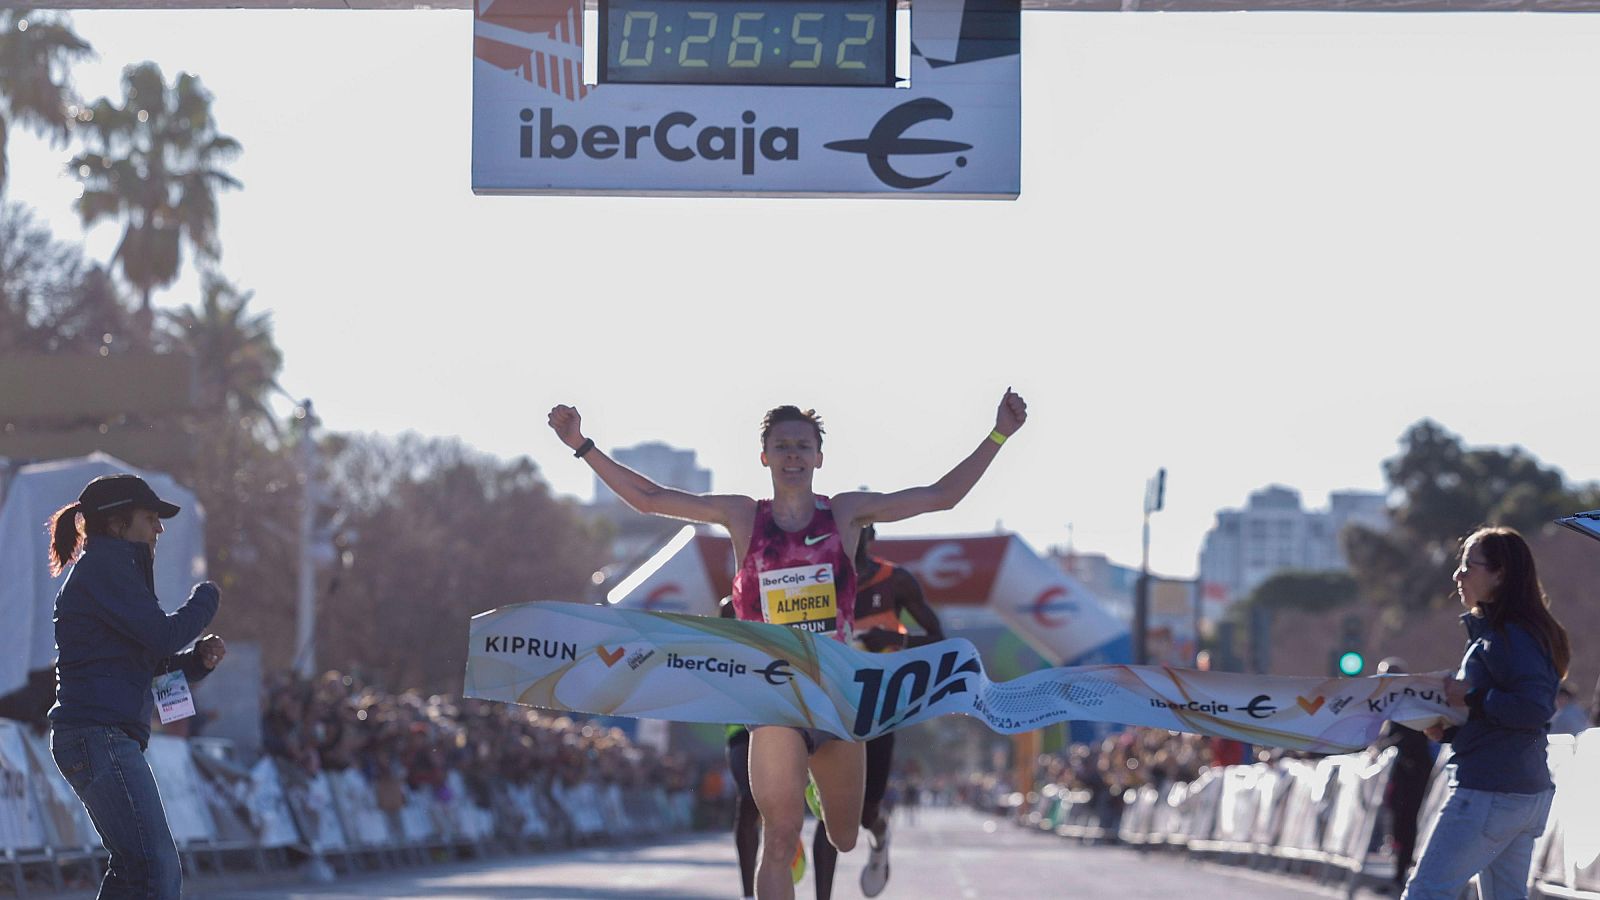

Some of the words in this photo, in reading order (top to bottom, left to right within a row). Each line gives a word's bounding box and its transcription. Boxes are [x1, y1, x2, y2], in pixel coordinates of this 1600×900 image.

[619, 11, 875, 69] 0:26:52
[519, 107, 799, 175] iberCaja
[762, 573, 805, 586] iberCaja
[777, 595, 830, 613] ALMGREN
[792, 621, 826, 633] RUN
[485, 636, 577, 661] KIPRUN
[667, 652, 747, 678] iberCaja
[1150, 698, 1229, 715] iberCaja
